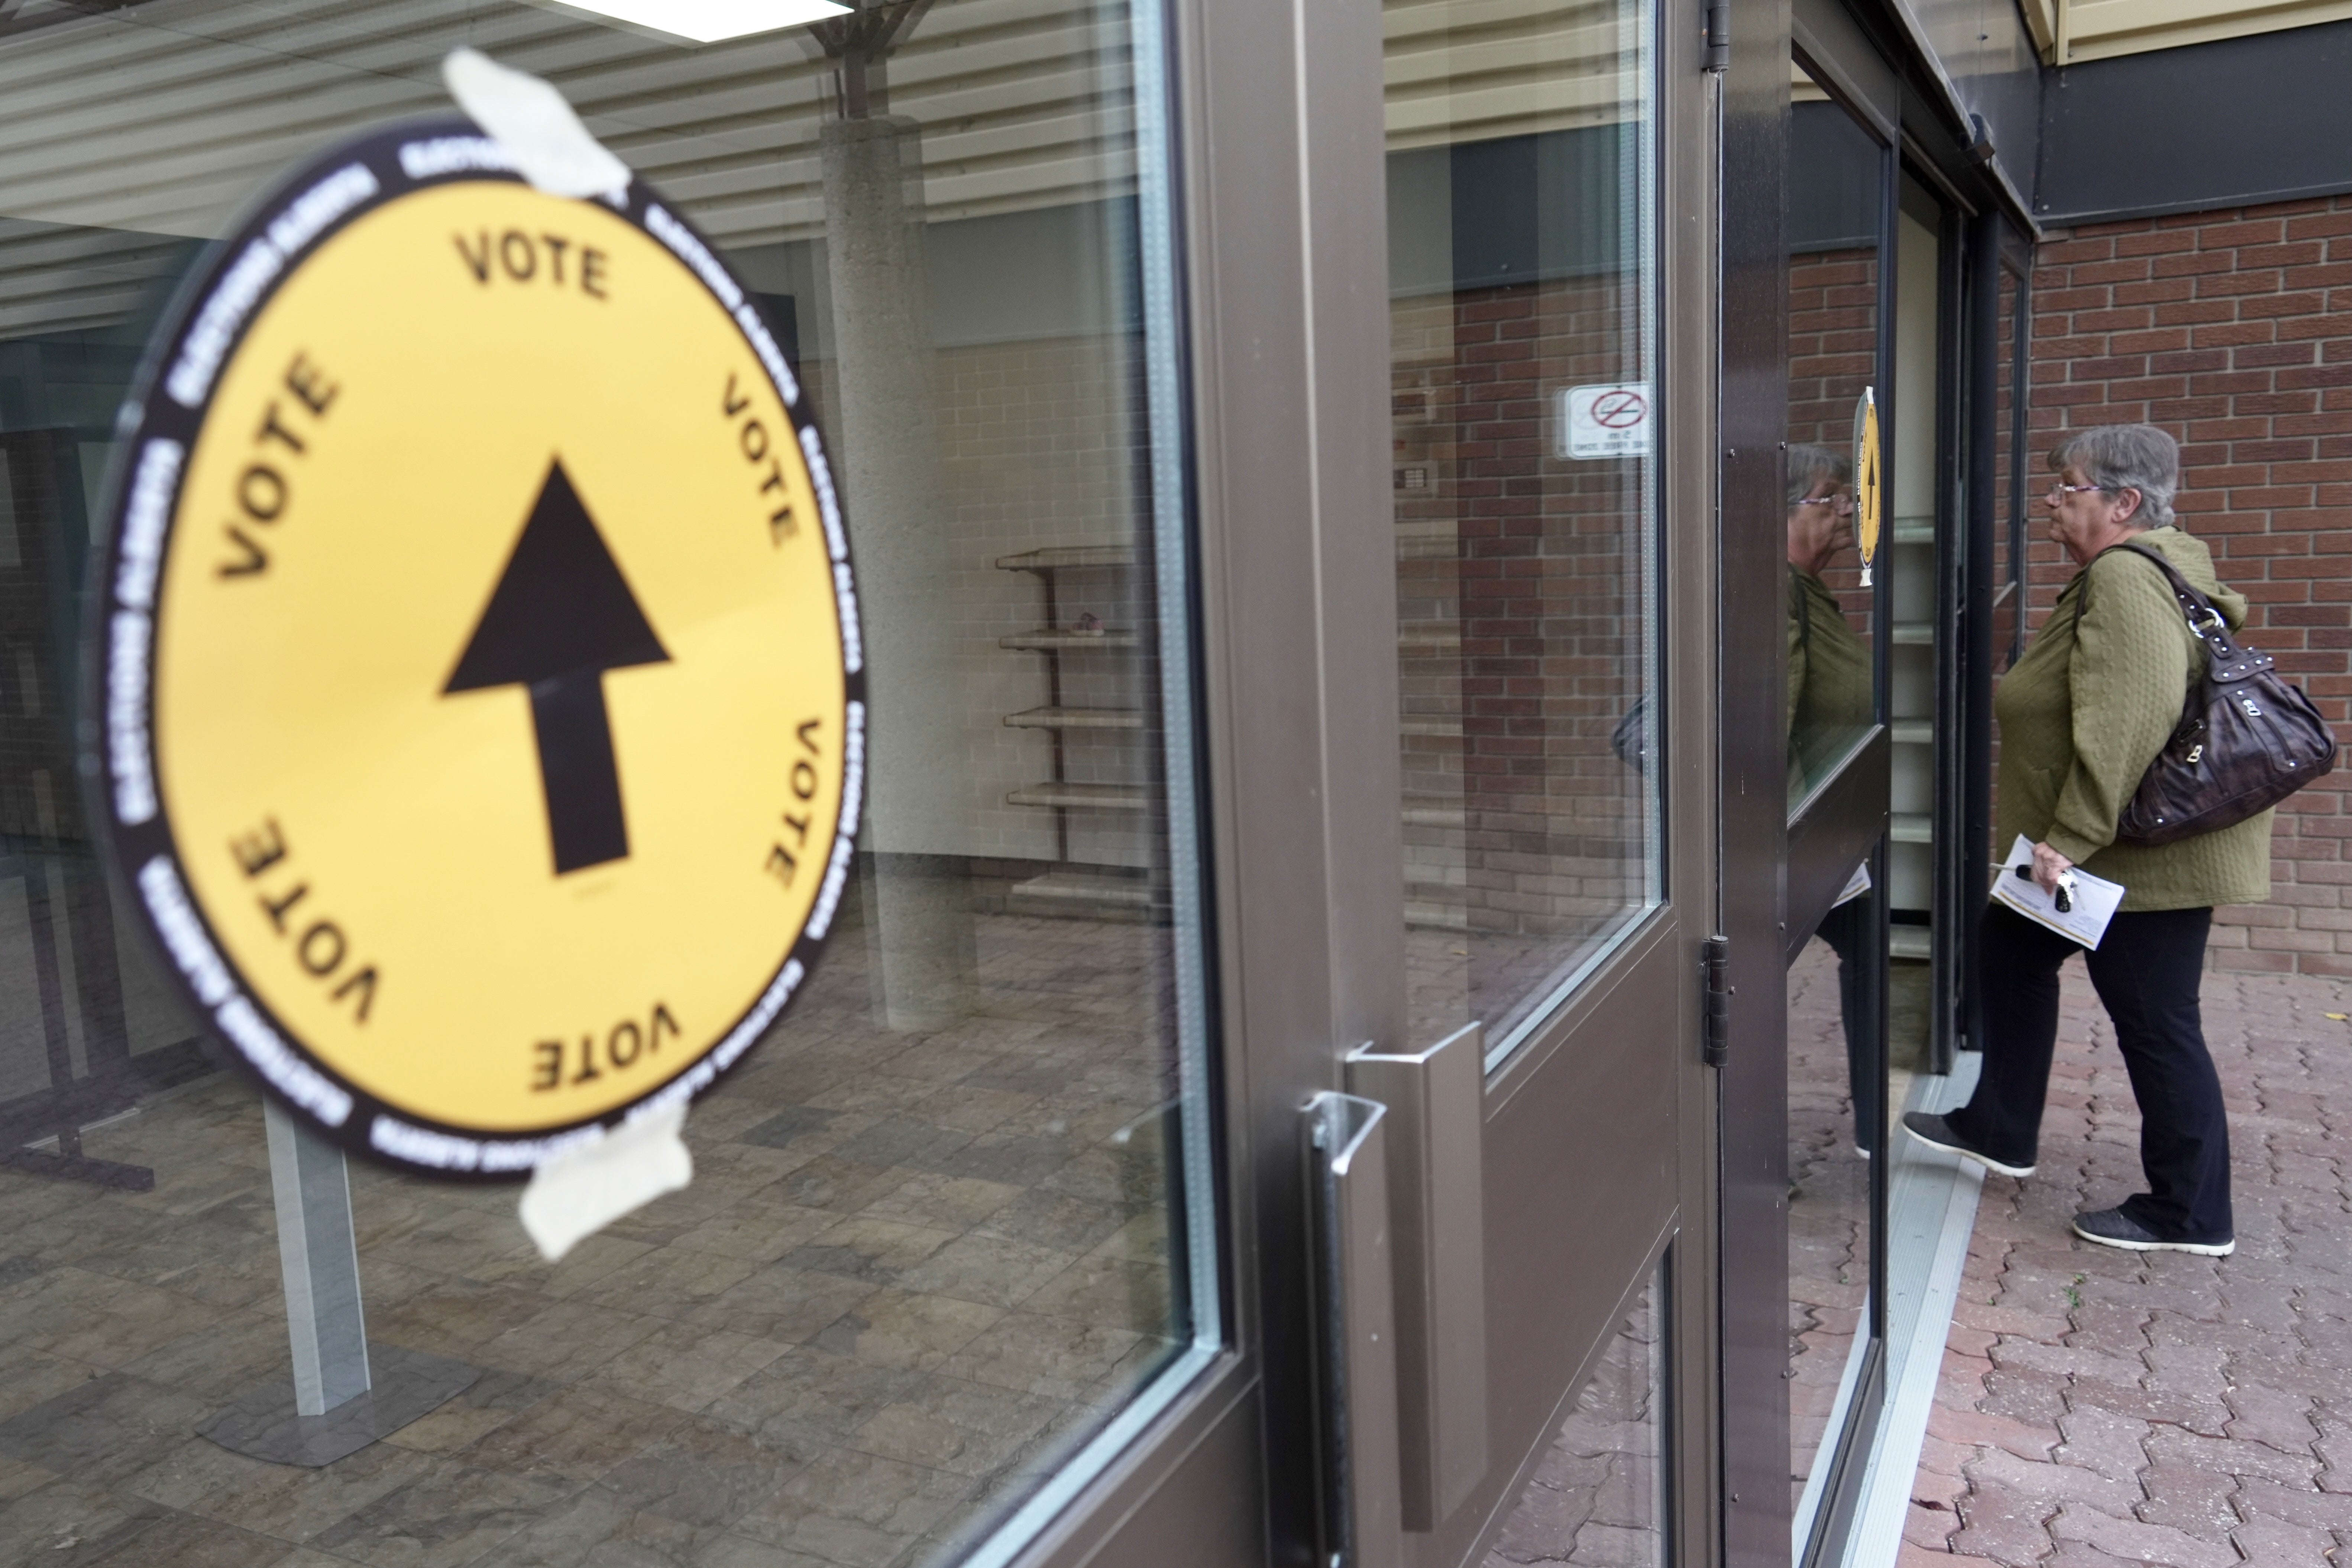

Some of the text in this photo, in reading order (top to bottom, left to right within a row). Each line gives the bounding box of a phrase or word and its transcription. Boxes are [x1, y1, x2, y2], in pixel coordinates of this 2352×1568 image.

[454, 229, 606, 300] VOTE
[214, 354, 339, 583] VOTE
[722, 374, 797, 546] VOTE
[766, 718, 822, 887] VOTE
[230, 818, 381, 1025] VOTE
[530, 1002, 682, 1093] VOTE
